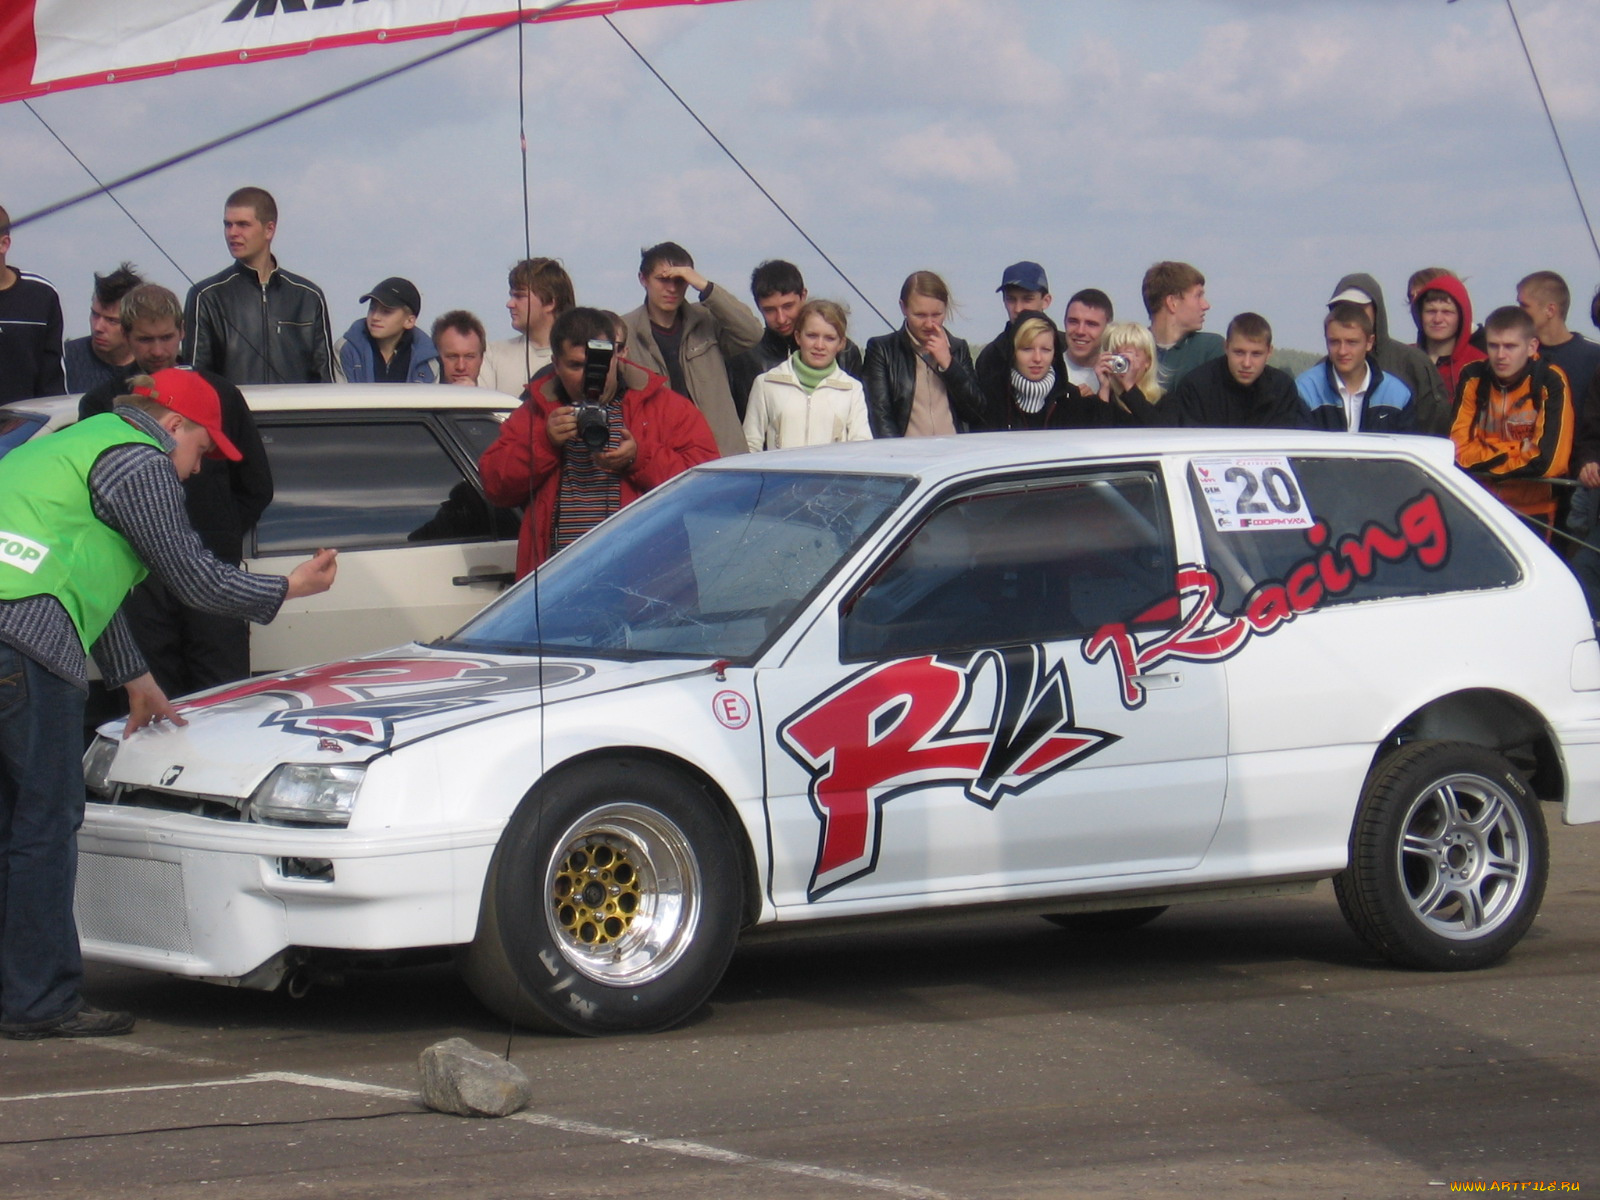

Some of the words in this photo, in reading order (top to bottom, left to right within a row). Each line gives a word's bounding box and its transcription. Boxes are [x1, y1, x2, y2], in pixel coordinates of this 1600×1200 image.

[1224, 467, 1301, 514] 20
[1080, 489, 1450, 711] Racing
[722, 698, 741, 721] E
